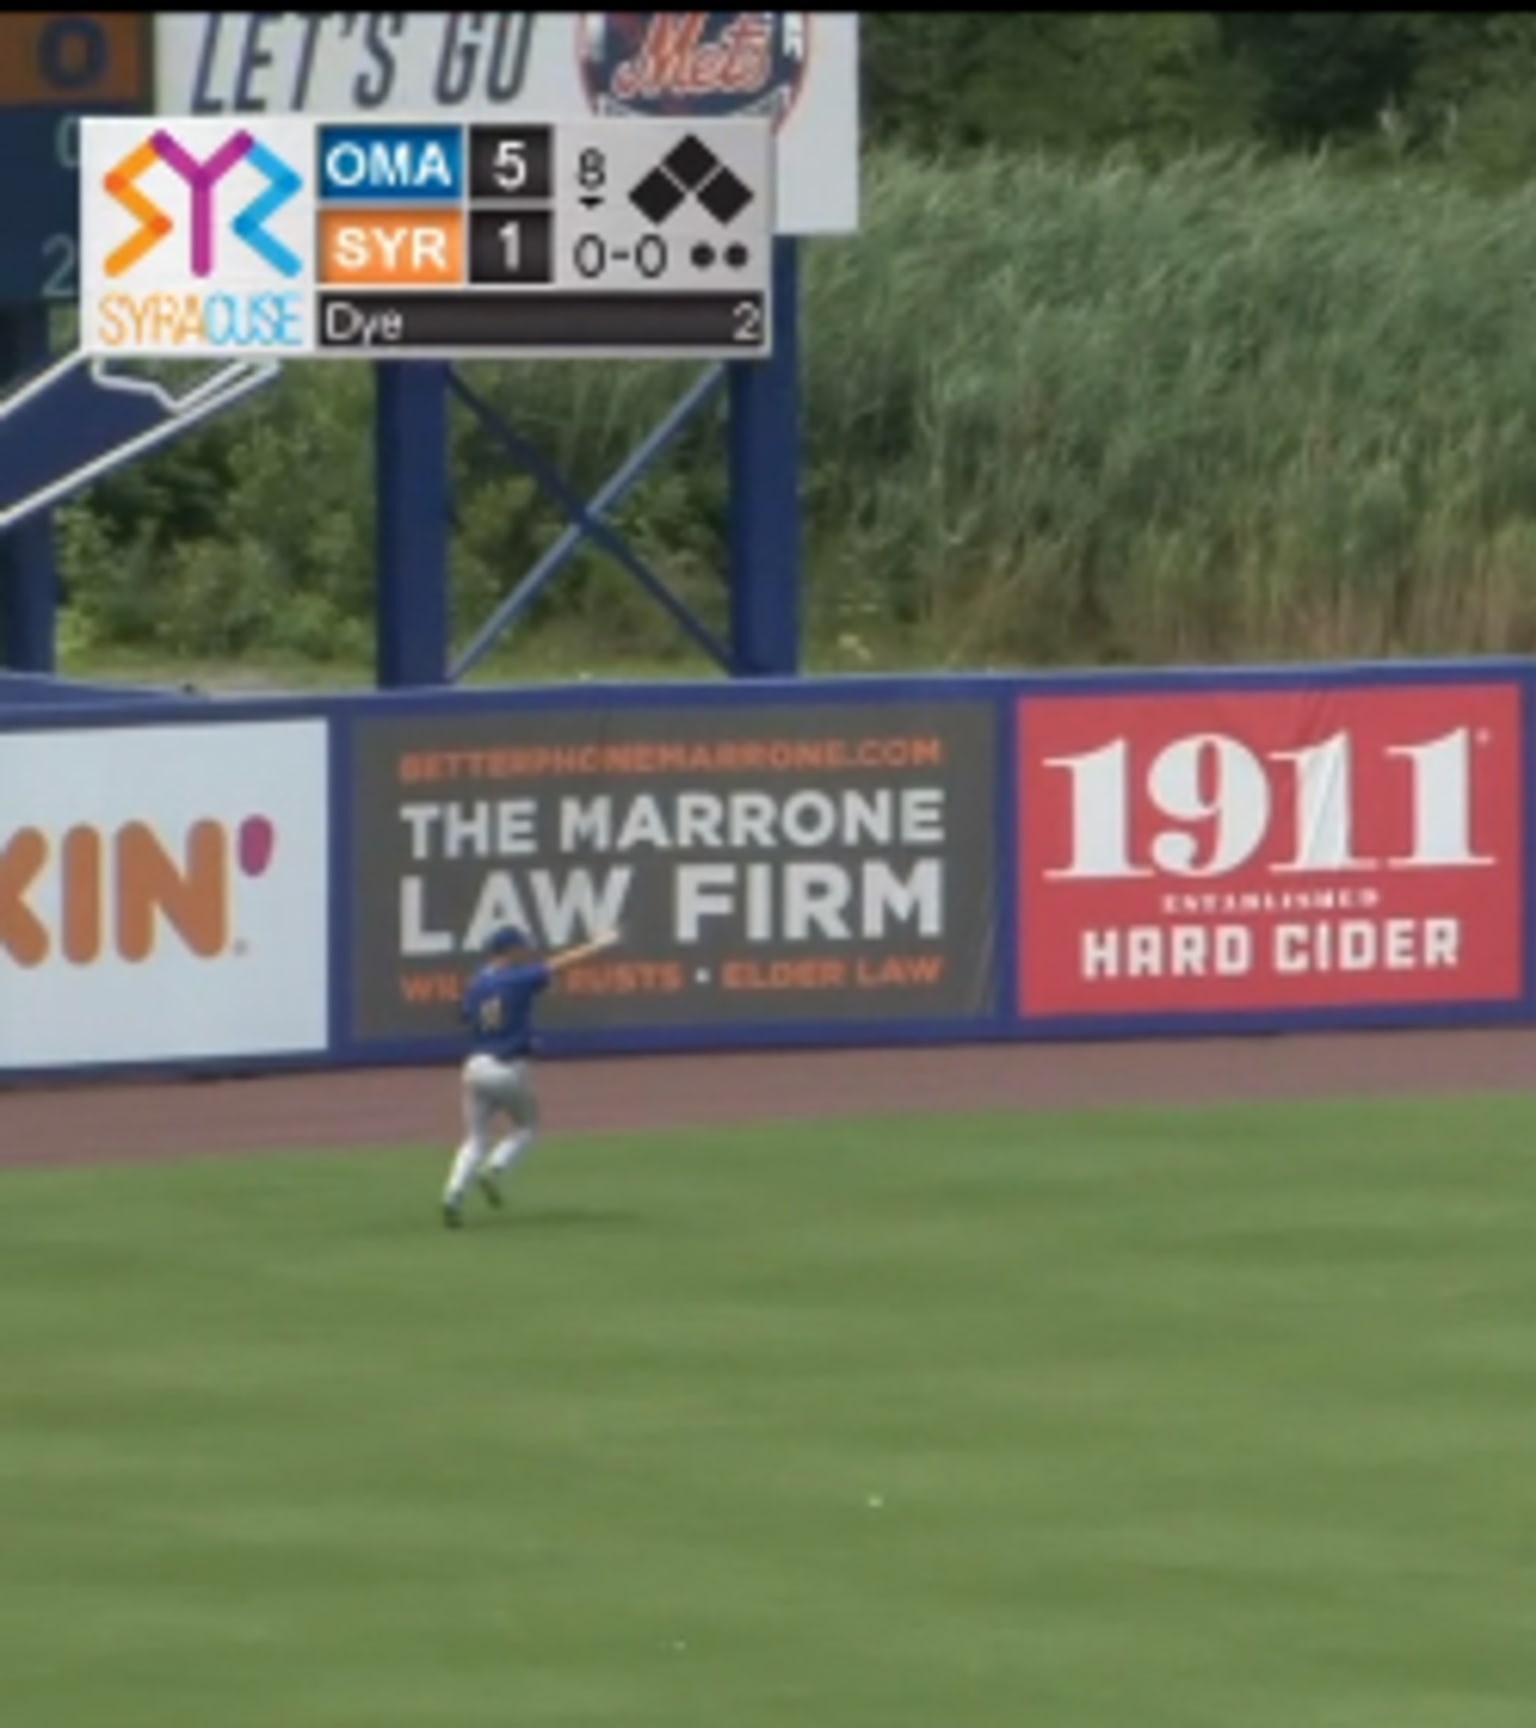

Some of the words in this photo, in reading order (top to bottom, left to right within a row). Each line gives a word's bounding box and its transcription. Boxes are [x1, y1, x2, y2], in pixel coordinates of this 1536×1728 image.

[190, 12, 402, 115] LET'S
[432, 12, 530, 104] GO
[400, 801, 537, 859] THE
[560, 788, 945, 853] MARRONE
[1042, 726, 1496, 879] 1911
[401, 866, 632, 956] LAW
[676, 858, 943, 942] FIRM
[1082, 925, 1251, 979] HARD
[1274, 917, 1459, 973] CIDER
[721, 958, 846, 988] ELDER
[857, 956, 941, 986] LAW
